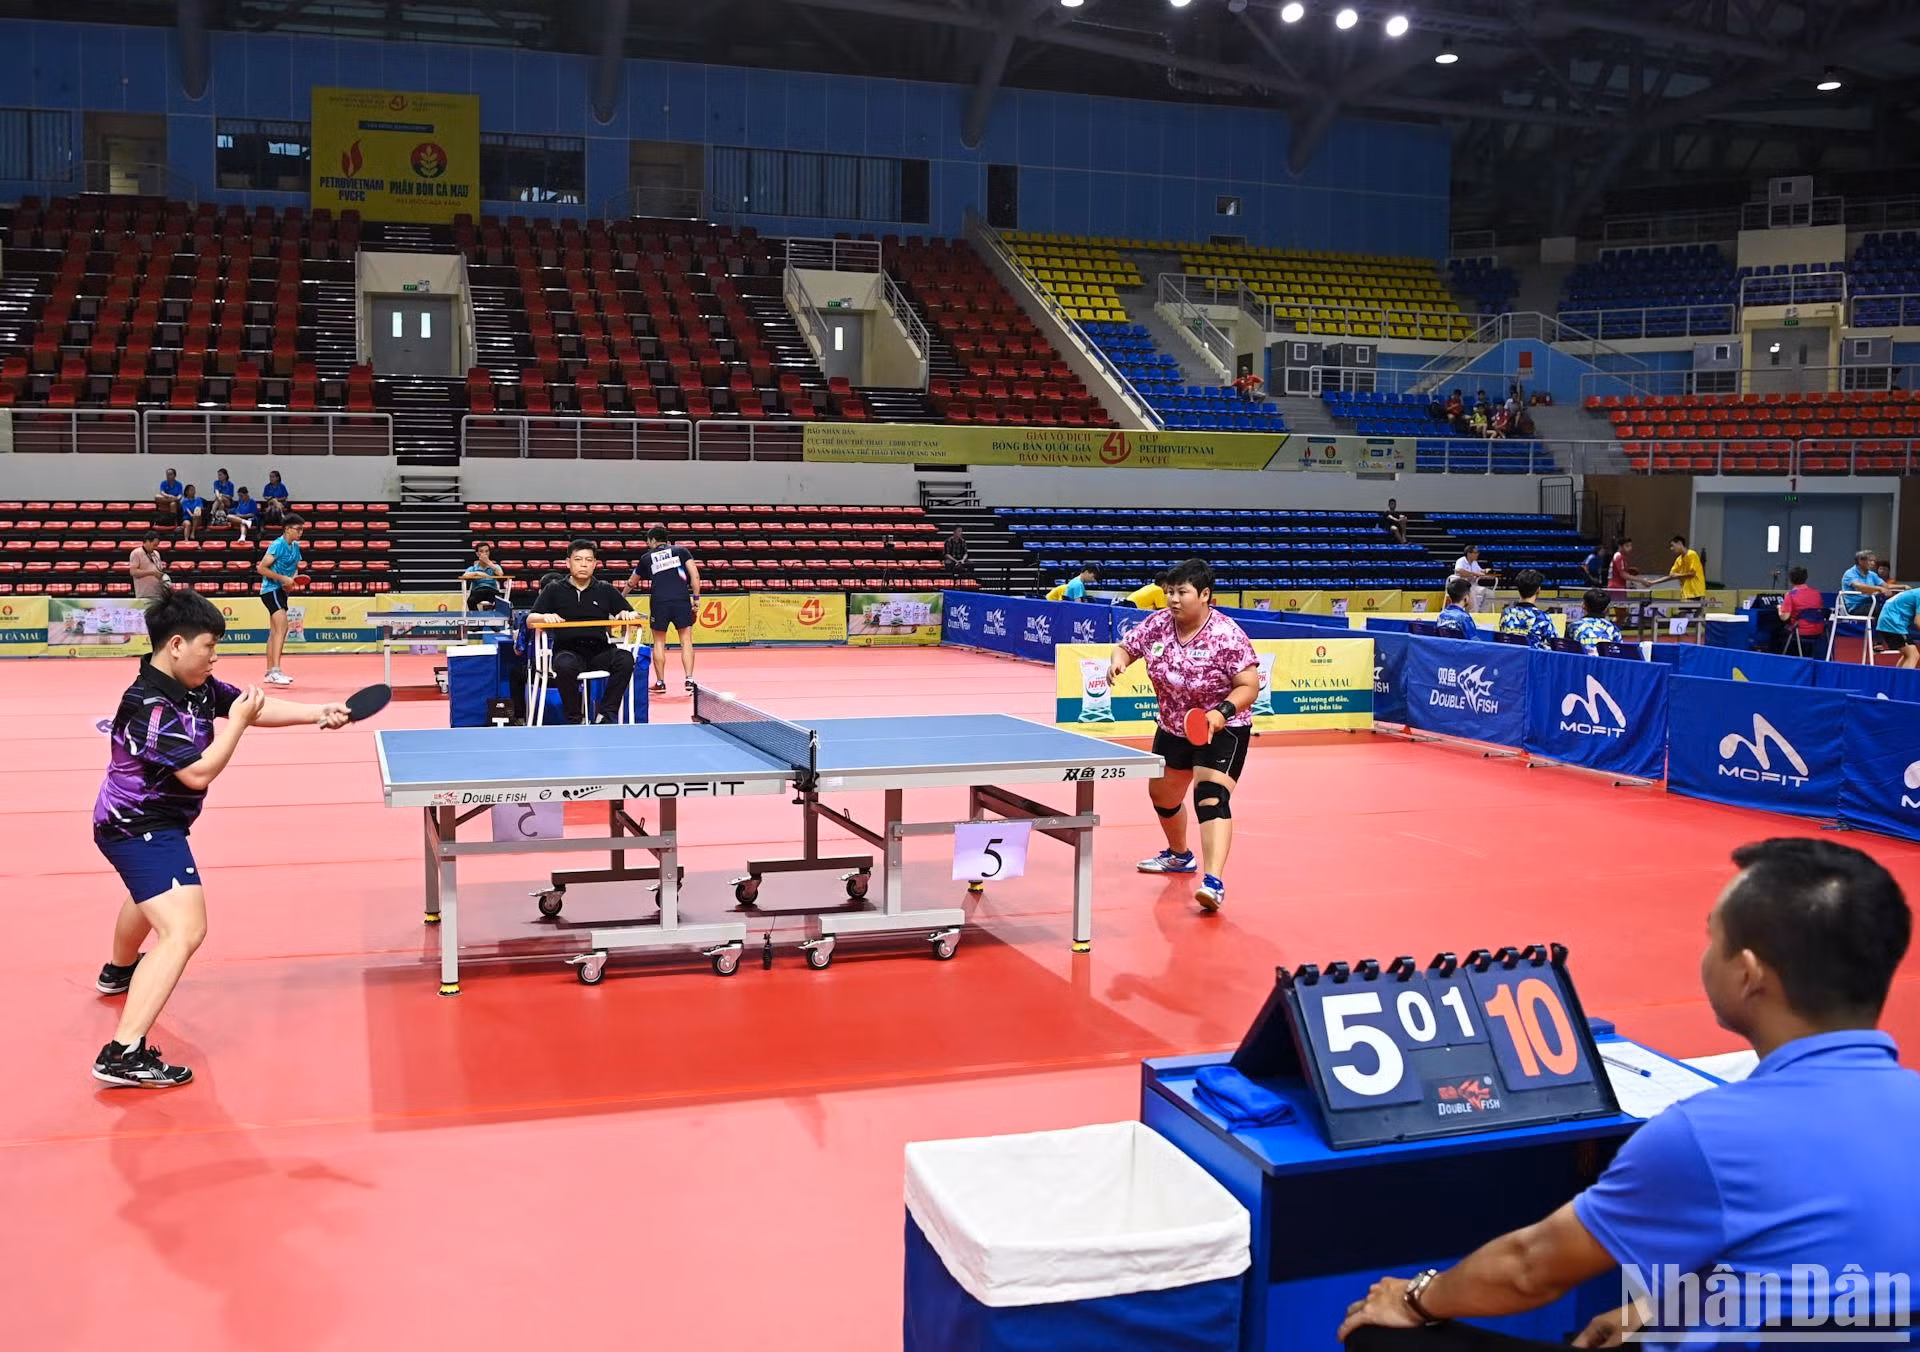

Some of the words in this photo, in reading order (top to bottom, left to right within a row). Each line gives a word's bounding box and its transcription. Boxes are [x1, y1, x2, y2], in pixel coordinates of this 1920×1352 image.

[320, 176, 385, 191] PETROVIETNAM
[390, 179, 413, 195] PHÂN
[450, 184, 468, 198] MAU
[338, 190, 365, 202] PVCFC
[1102, 432, 1125, 456] 41
[1139, 434, 1158, 443] CUP
[1075, 443, 1092, 452] GIA
[1139, 445, 1214, 455] PETROVIETNAM
[1139, 455, 1170, 464] PVCFC
[1789, 478, 1797, 491] 1
[703, 601, 721, 621] 41
[801, 599, 820, 618] 41
[1676, 624, 1683, 633] 6
[20, 632, 40, 640] MAU
[234, 633, 251, 641] BIO
[338, 632, 357, 640] BIO
[1291, 679, 1311, 688] NPK
[1314, 676, 1326, 687] CÀ
[1330, 678, 1352, 687] MAU
[1438, 667, 1457, 687] 双鱼
[1132, 684, 1153, 694] NPK
[1374, 681, 1390, 693] ISH
[1429, 689, 1466, 710] DOUBLE
[1477, 699, 1499, 714] FISH
[1560, 720, 1625, 738] MOFIT
[1062, 767, 1096, 782] 双鱼
[1101, 767, 1126, 779] 235
[1718, 764, 1809, 787] MOFIT
[622, 781, 745, 798] MOFIT
[462, 792, 503, 804] DOUBLE
[505, 792, 527, 802] FISH
[981, 838, 1004, 877] 5
[1321, 991, 1404, 1096] 5
[1396, 990, 1438, 1042] 0
[1441, 986, 1475, 1038] 1
[1484, 978, 1579, 1078] 10
[1438, 1102, 1473, 1116] DOUBLE
[1480, 1099, 1501, 1110] FISH
